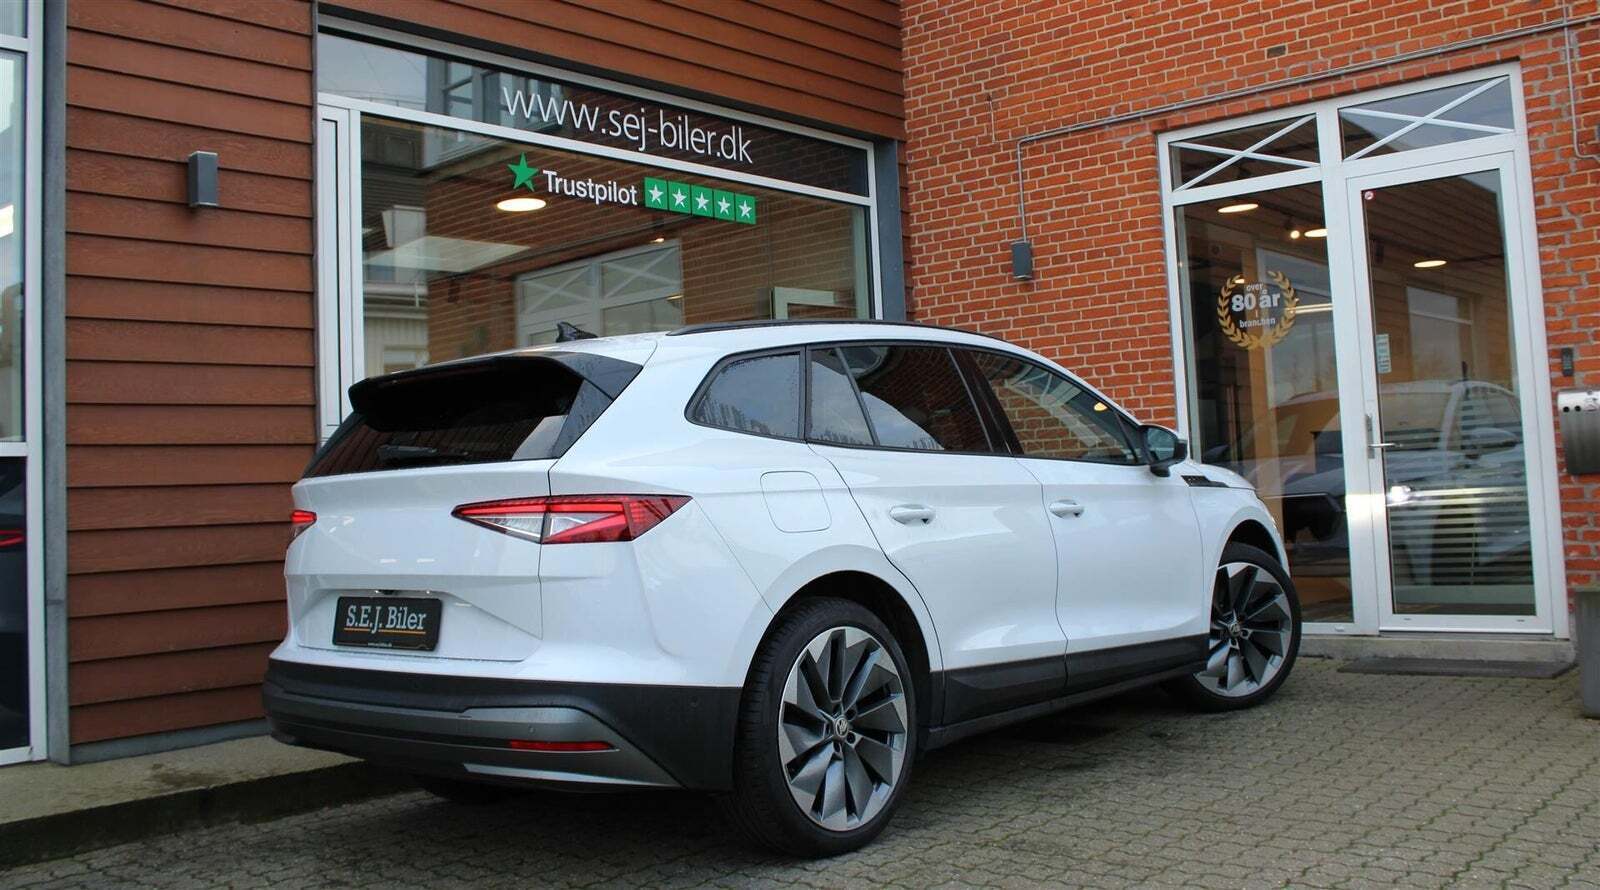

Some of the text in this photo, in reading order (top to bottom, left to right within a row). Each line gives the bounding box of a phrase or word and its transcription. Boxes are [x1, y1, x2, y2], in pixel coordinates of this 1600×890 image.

[503, 87, 753, 164] www.sej-biler.dk
[543, 169, 638, 205] Trustpilot
[1231, 289, 1281, 312] 80 år
[346, 603, 427, 634] S.E.J. Biler
